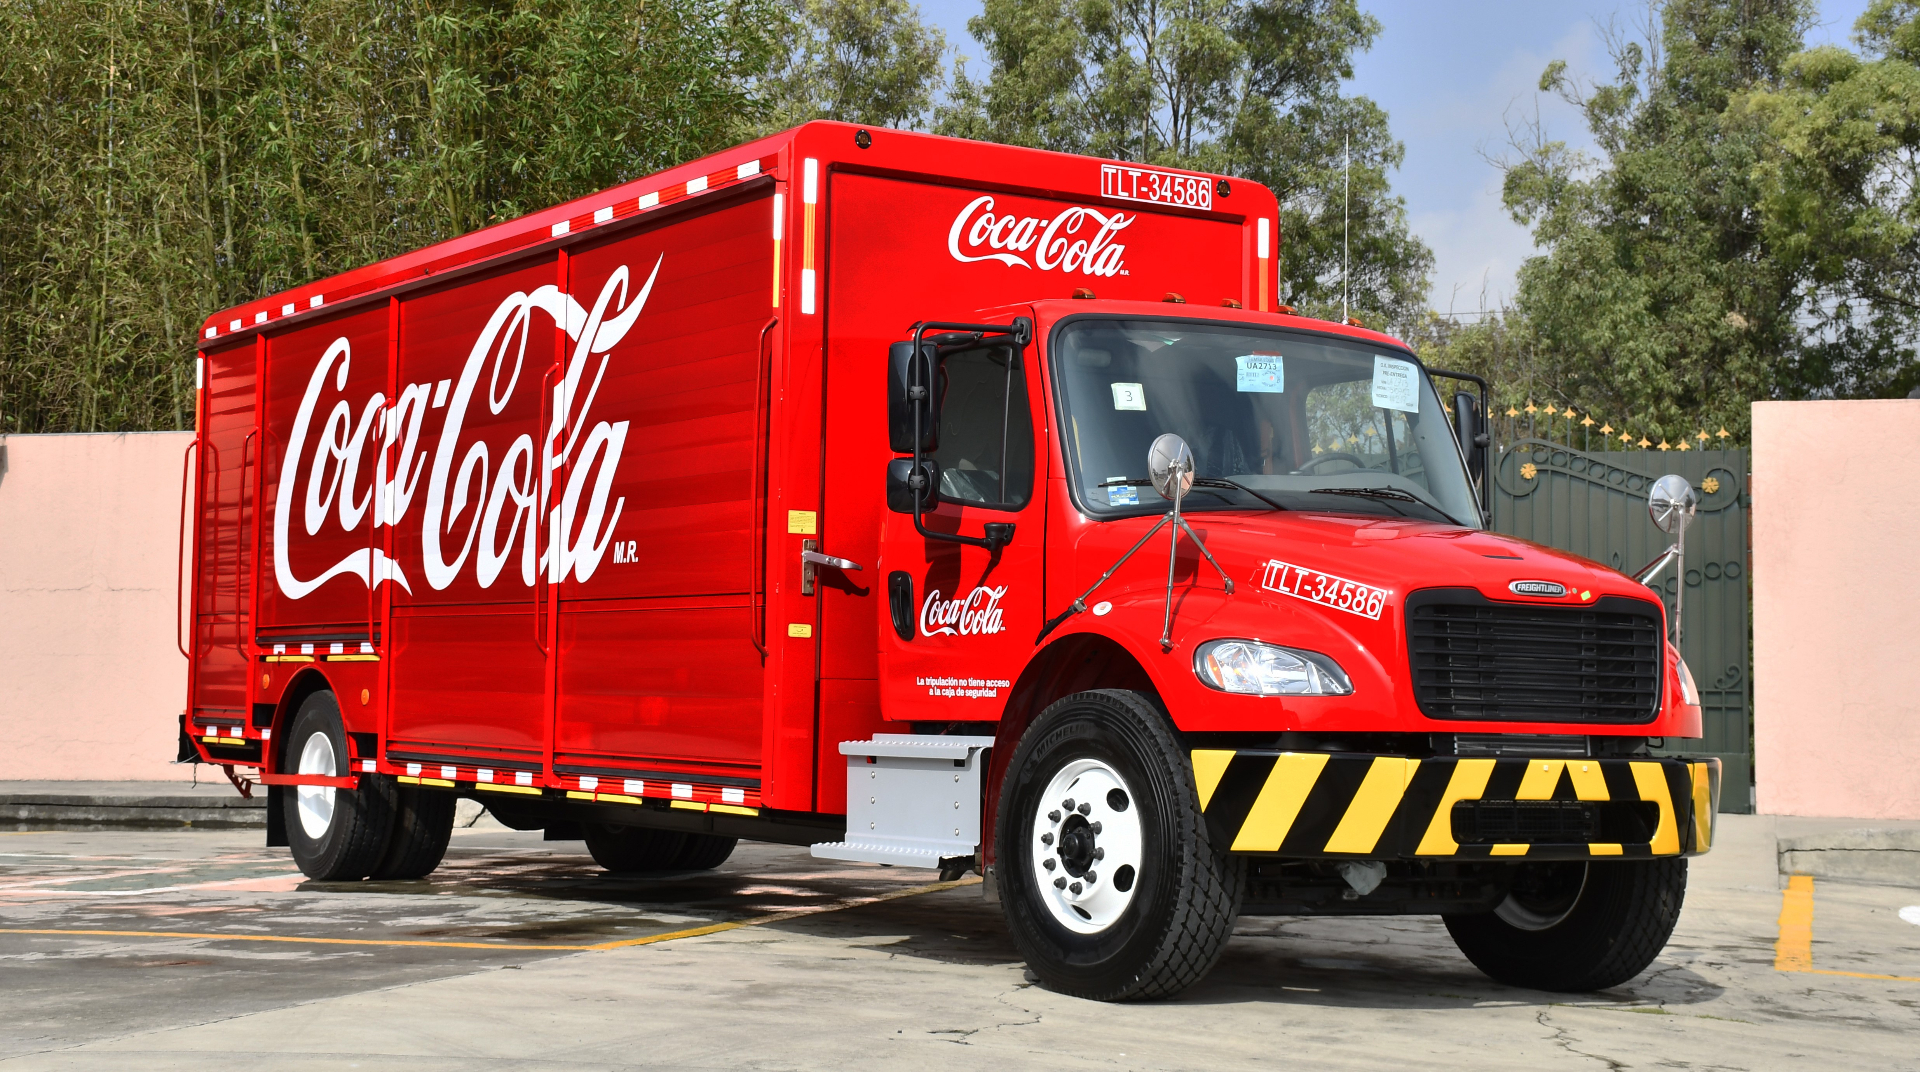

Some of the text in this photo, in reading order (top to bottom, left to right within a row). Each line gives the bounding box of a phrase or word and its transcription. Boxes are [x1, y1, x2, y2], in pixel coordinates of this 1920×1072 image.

[1103, 167, 1210, 208] TLT-34586
[948, 195, 1137, 277] Coca-Cola
[1246, 362, 1277, 370] UA2713
[1124, 390, 1133, 401] 3
[273, 251, 664, 600] Coca-Cola
[613, 540, 639, 564] M.R.
[1268, 562, 1383, 616] TLT-34586
[1517, 583, 1563, 593] FREIGHTLINER
[919, 585, 1009, 637] Coca-Cola
[916, 676, 925, 685] La
[925, 676, 958, 688] tripulación
[968, 677, 985, 687] tiene
[985, 679, 1010, 687] acceso
[934, 686, 941, 695] la
[941, 687, 955, 698] caja
[956, 687, 965, 696] de
[965, 687, 997, 699] seguridad
